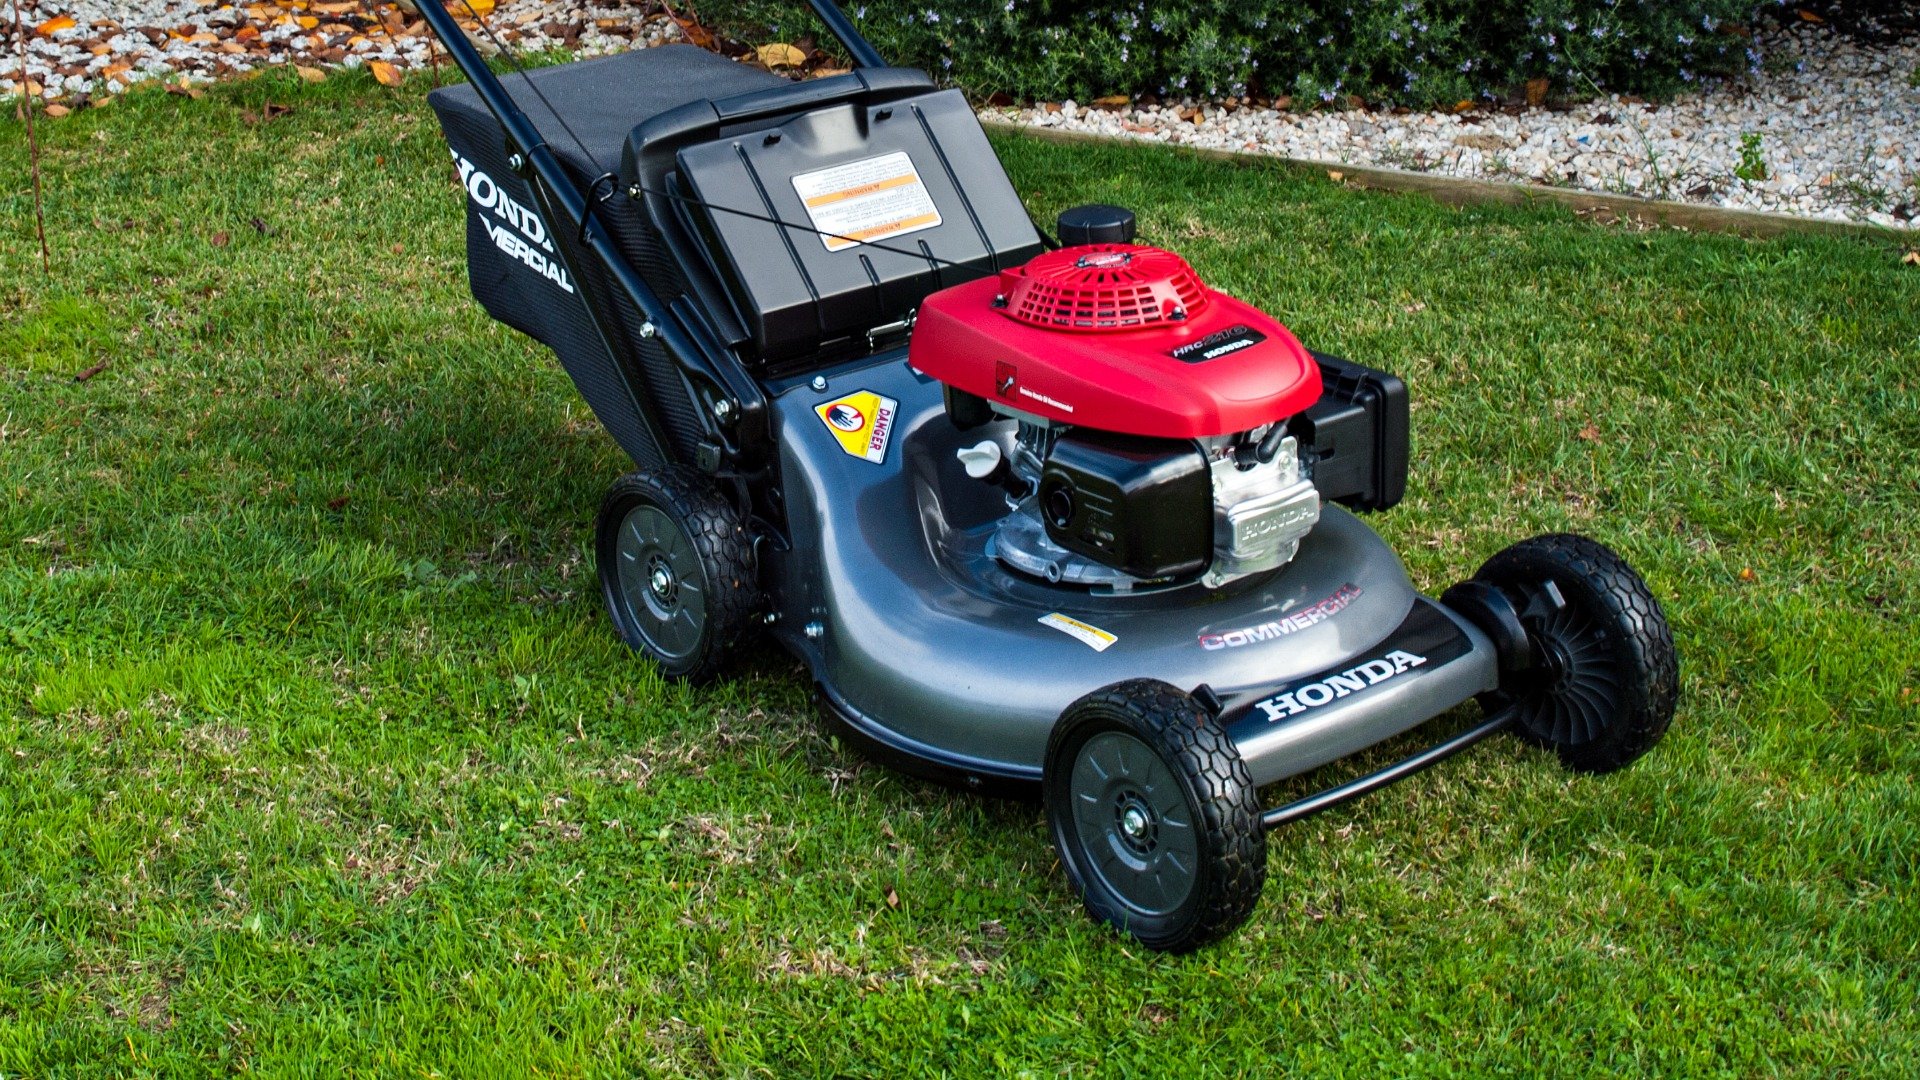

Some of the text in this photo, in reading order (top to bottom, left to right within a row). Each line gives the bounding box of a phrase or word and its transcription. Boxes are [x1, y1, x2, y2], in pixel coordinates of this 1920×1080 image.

[1203, 339, 1254, 359] HONDA
[869, 408, 891, 451] DANGER
[1241, 507, 1315, 540] HONDA
[1198, 582, 1362, 651] COMMERCIAL
[1255, 649, 1428, 722] HONDA
